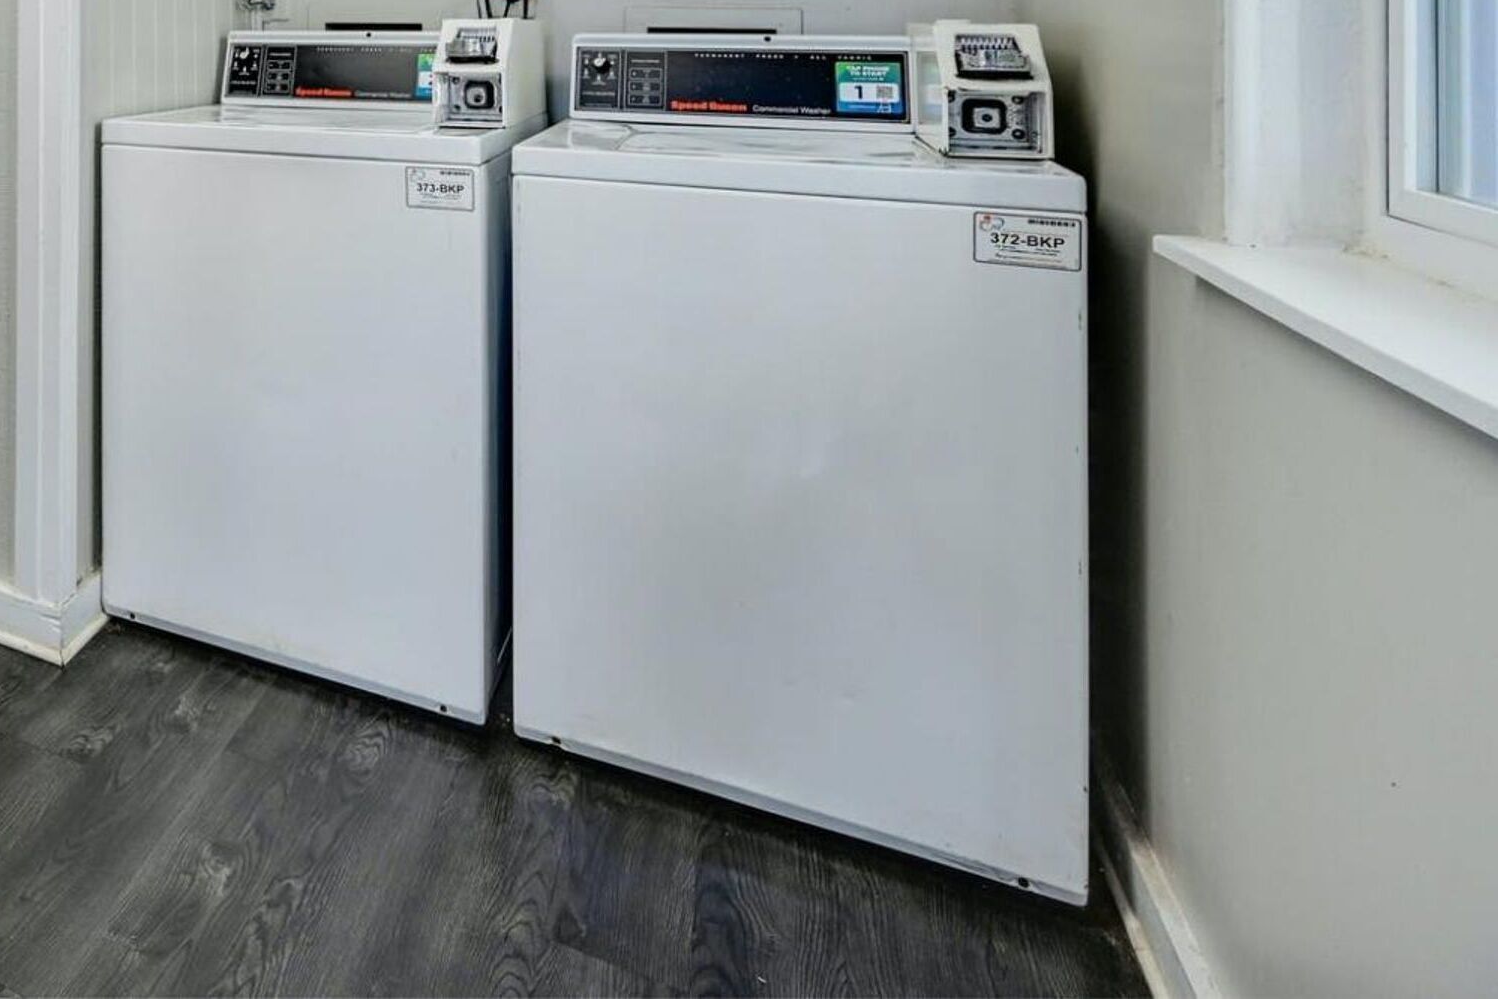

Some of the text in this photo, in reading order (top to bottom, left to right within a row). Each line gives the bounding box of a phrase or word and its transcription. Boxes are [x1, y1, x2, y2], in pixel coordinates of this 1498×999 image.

[854, 85, 863, 100] 1
[670, 100, 707, 111] Speed
[709, 101, 747, 113] Queen
[416, 182, 465, 194] 373-BKP
[990, 232, 1065, 248] 372-BKP
